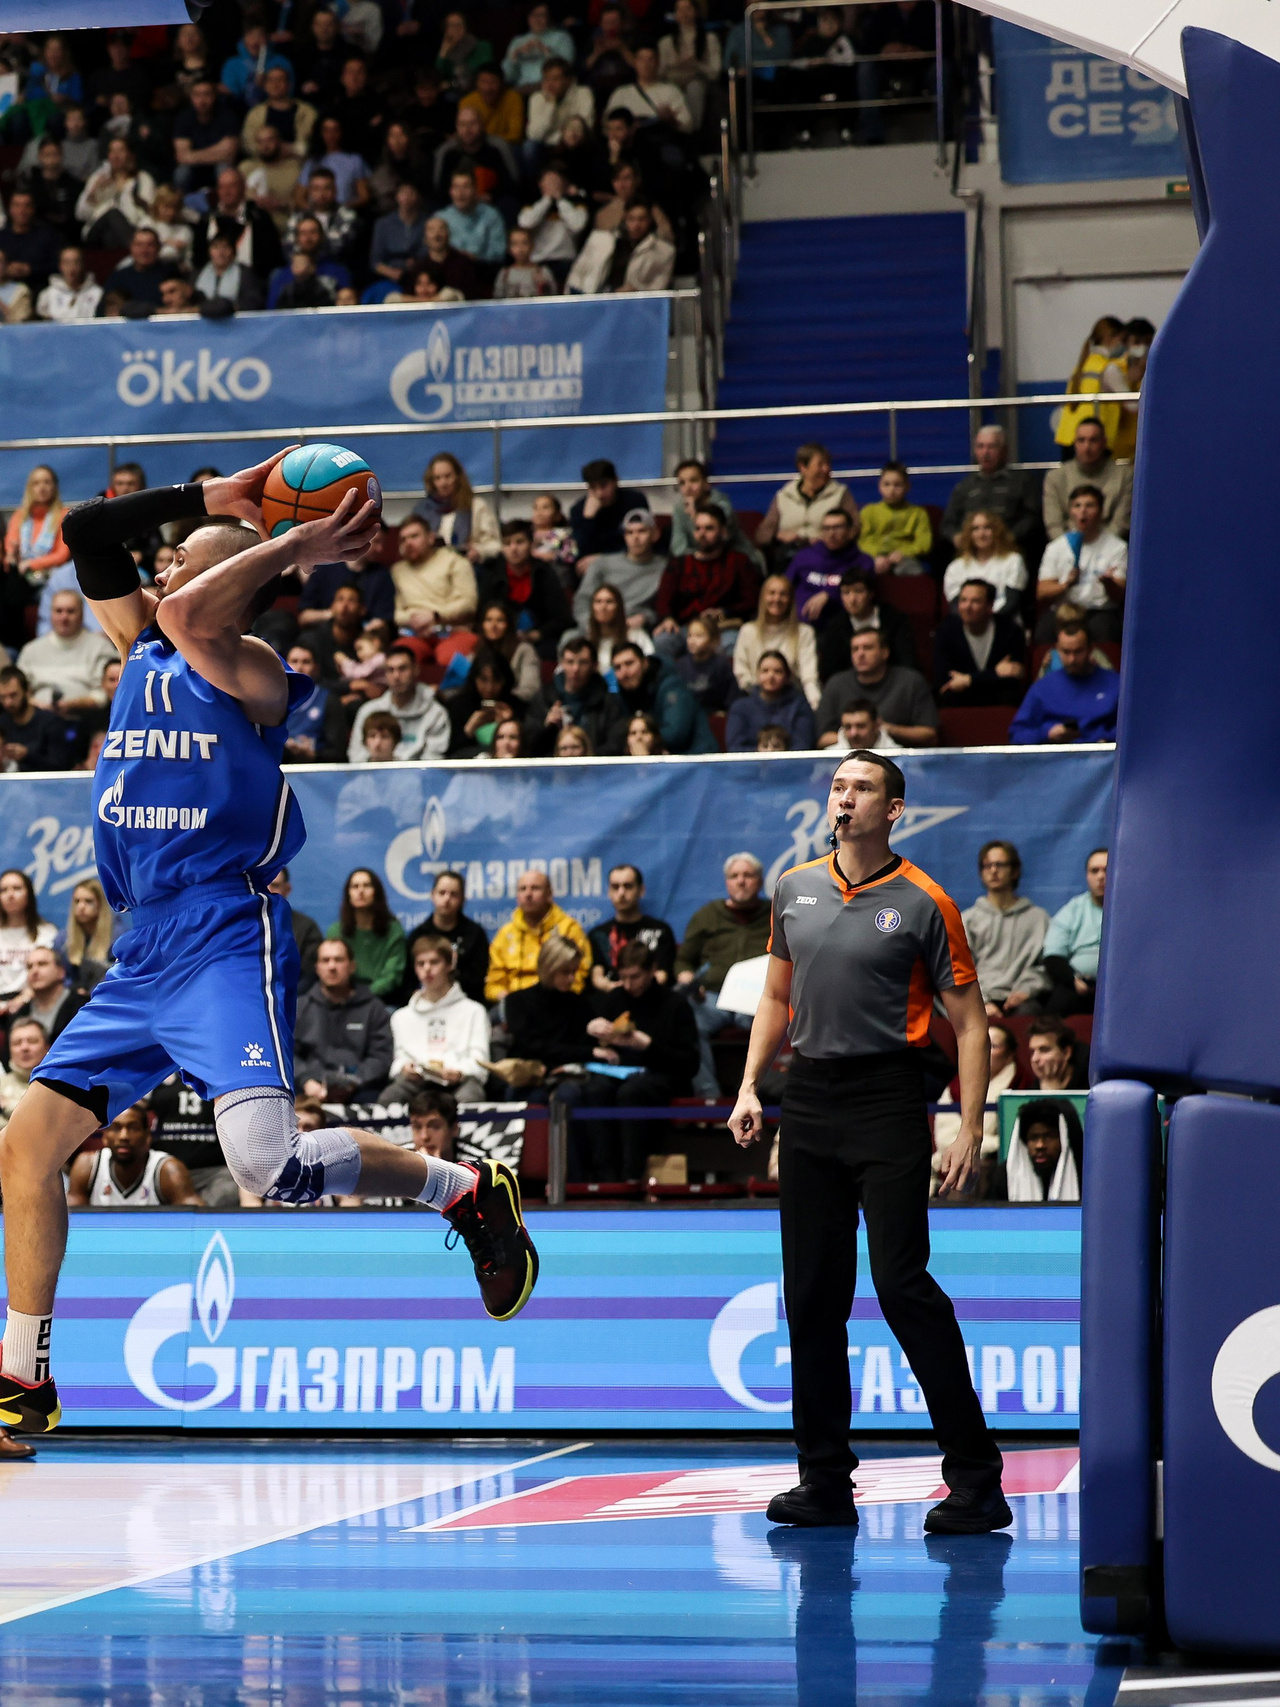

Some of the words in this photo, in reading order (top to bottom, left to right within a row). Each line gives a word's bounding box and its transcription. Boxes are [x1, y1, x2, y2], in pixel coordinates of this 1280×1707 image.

[455, 342, 583, 380] ГАЗПРОМ
[144, 670, 174, 713] 11
[103, 729, 219, 763] ZENIT
[126, 806, 208, 830] ГАЗПРОМ
[240, 1059, 272, 1068] KELME
[239, 1345, 516, 1413] ГАЗПРОМ
